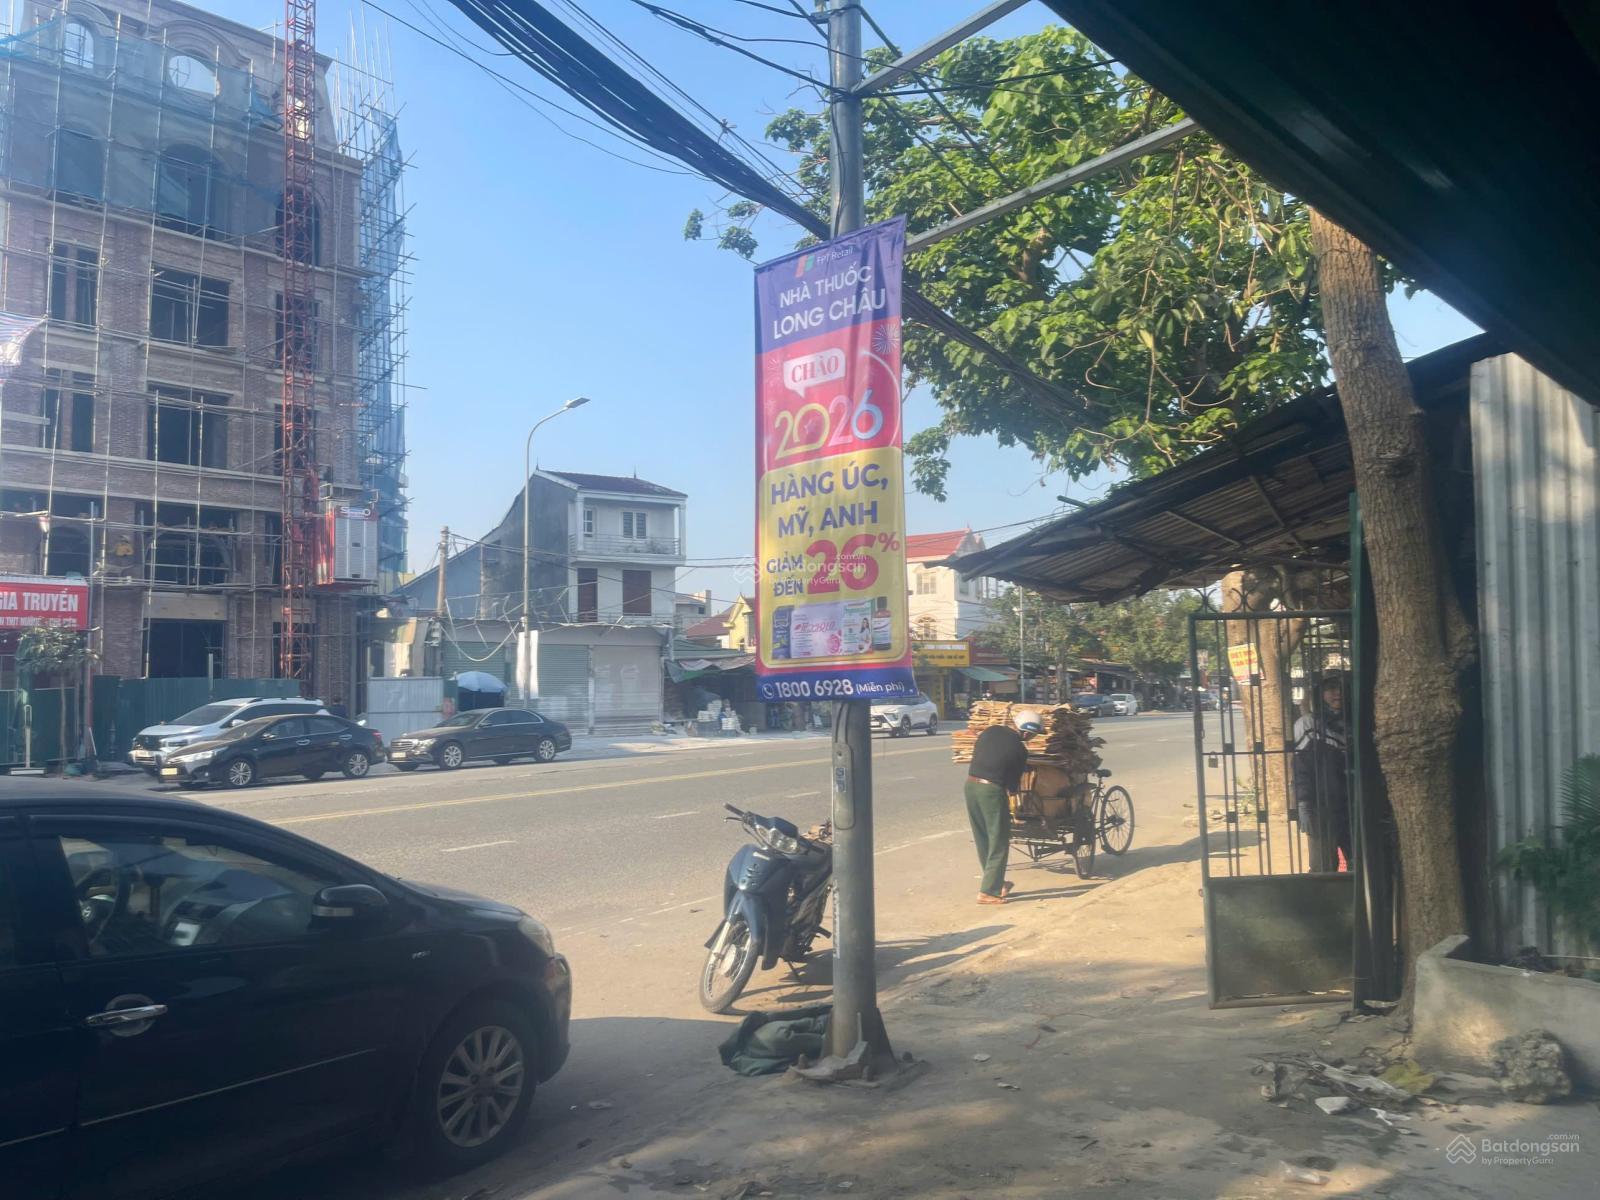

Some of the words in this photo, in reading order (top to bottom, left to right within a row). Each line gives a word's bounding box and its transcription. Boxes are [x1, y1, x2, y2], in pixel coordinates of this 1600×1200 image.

[816, 254, 830, 265] FPT
[831, 246, 854, 260] Retail
[779, 281, 812, 308] NHÀ
[815, 261, 872, 296] THUỐC
[773, 307, 825, 339] LONG
[828, 287, 886, 320] CHÂU
[791, 355, 840, 383] CHÀO
[774, 388, 884, 460] 2026
[771, 473, 835, 505] HÀNG
[842, 460, 889, 490] ÚC,
[778, 505, 814, 538] MỸ,
[819, 500, 879, 531] ANH
[766, 551, 804, 574] GIẢM
[773, 574, 804, 597] ĐẾN
[775, 680, 811, 698] 1800
[814, 678, 854, 696] 6928
